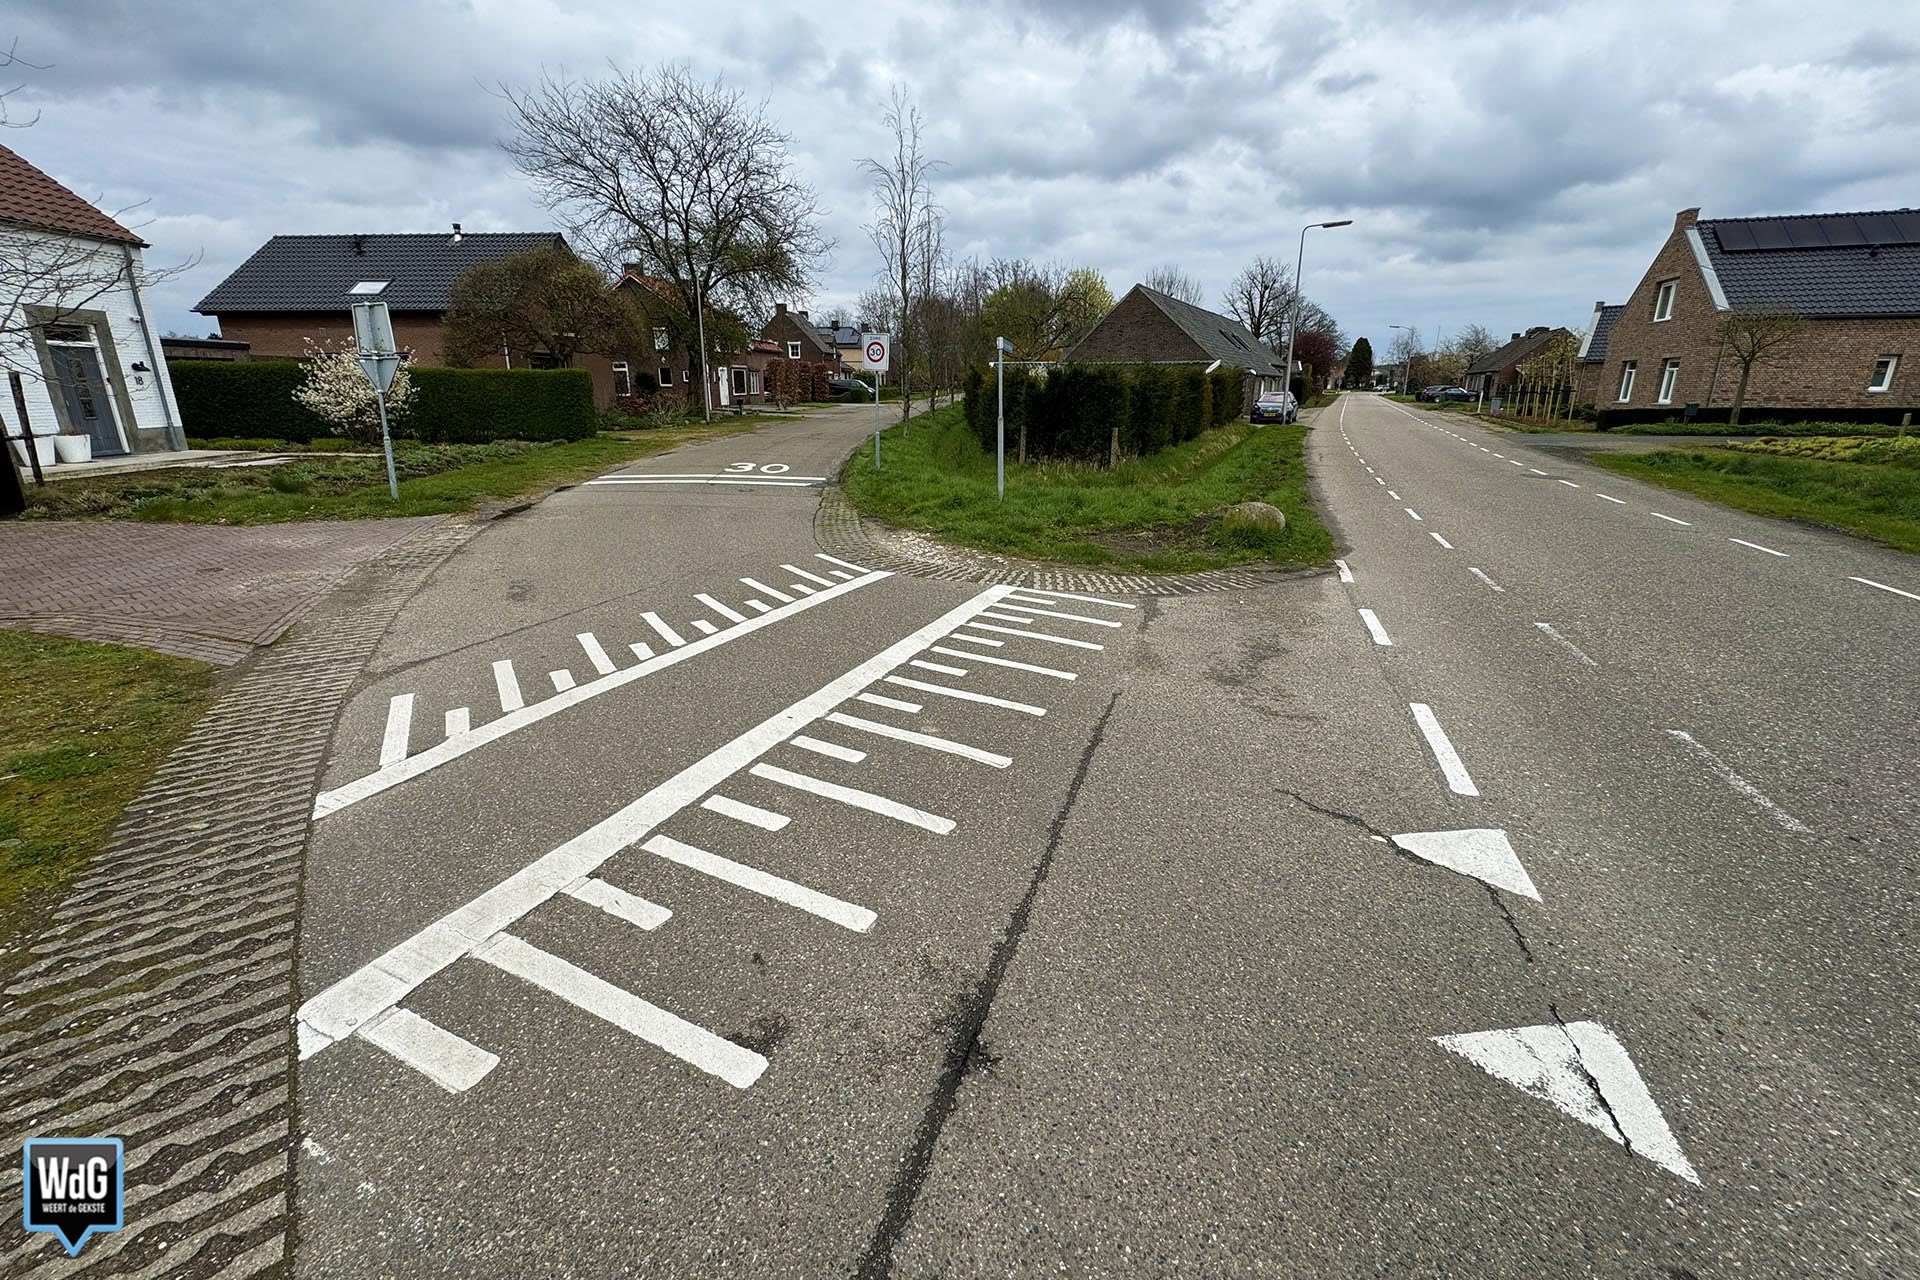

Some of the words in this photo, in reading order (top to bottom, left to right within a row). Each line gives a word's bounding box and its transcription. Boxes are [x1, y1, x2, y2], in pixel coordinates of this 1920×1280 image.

[870, 348, 881, 356] 30
[134, 376, 144, 385] 18
[724, 462, 790, 474] 30
